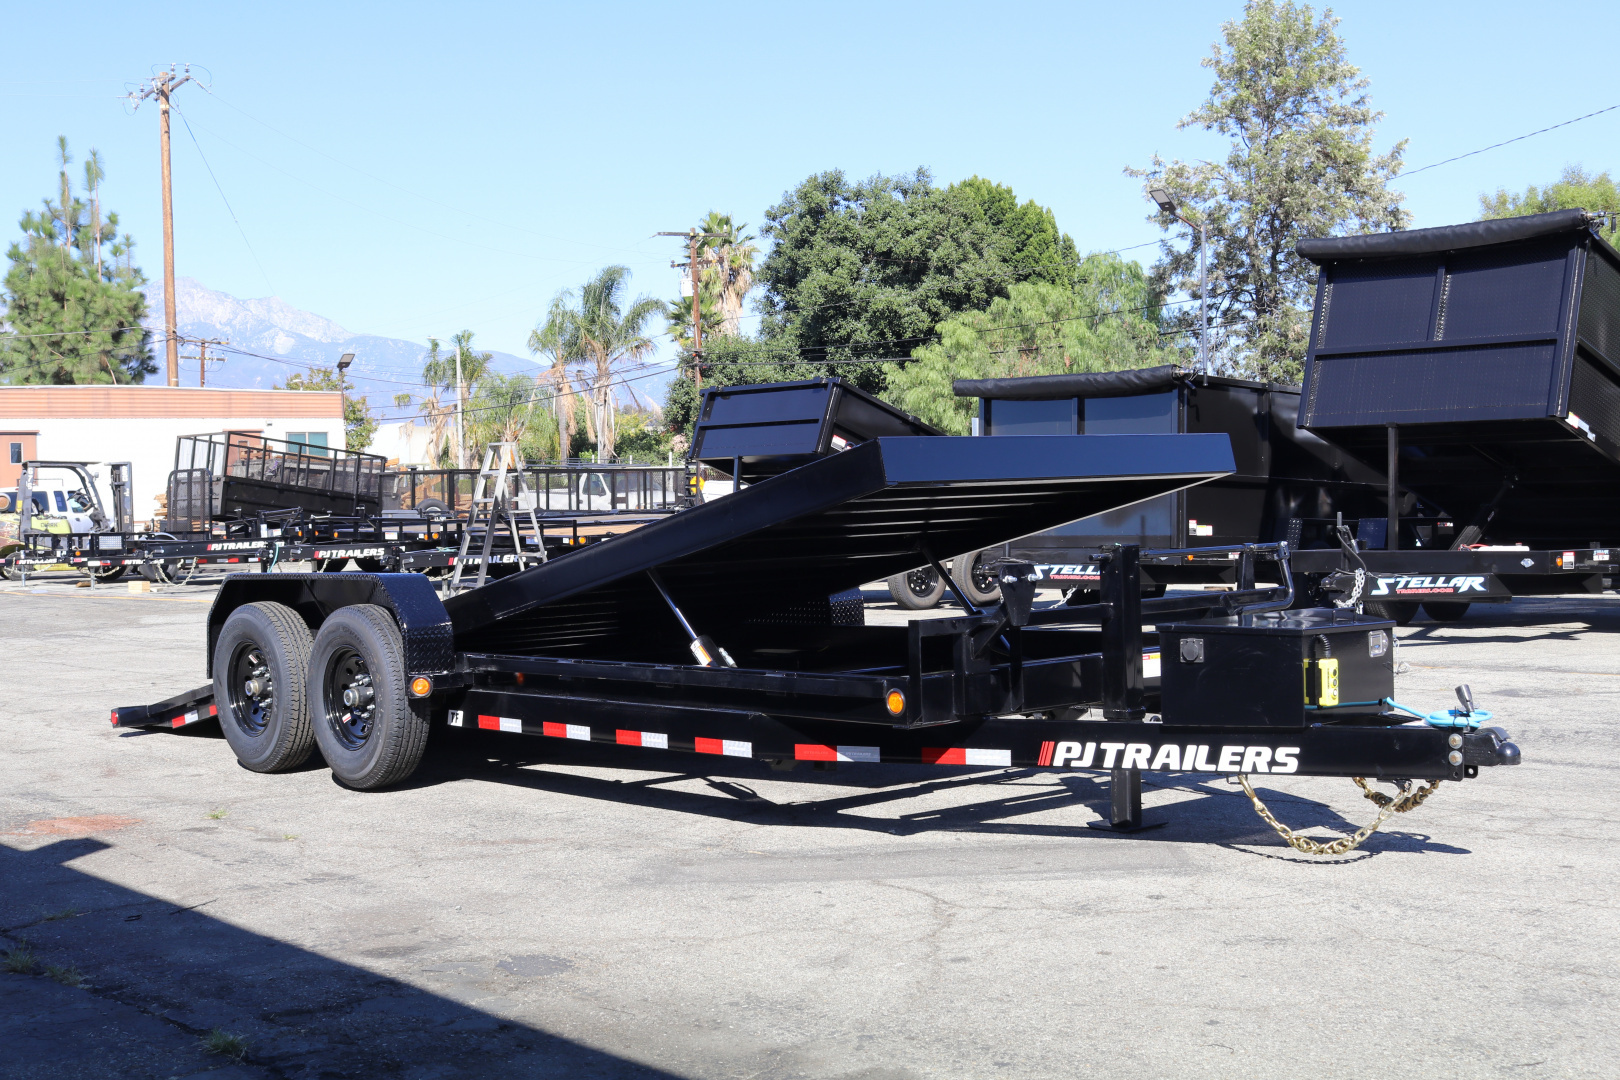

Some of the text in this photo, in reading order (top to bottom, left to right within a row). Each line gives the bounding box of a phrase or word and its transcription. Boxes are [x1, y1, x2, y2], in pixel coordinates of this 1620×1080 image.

[331, 547, 385, 558] TRAILERS
[1034, 564, 1100, 580] STELL
[1371, 576, 1487, 596] STELLAR
[451, 712, 459, 723] TF
[1052, 741, 1301, 774] PJ TRAILERS
